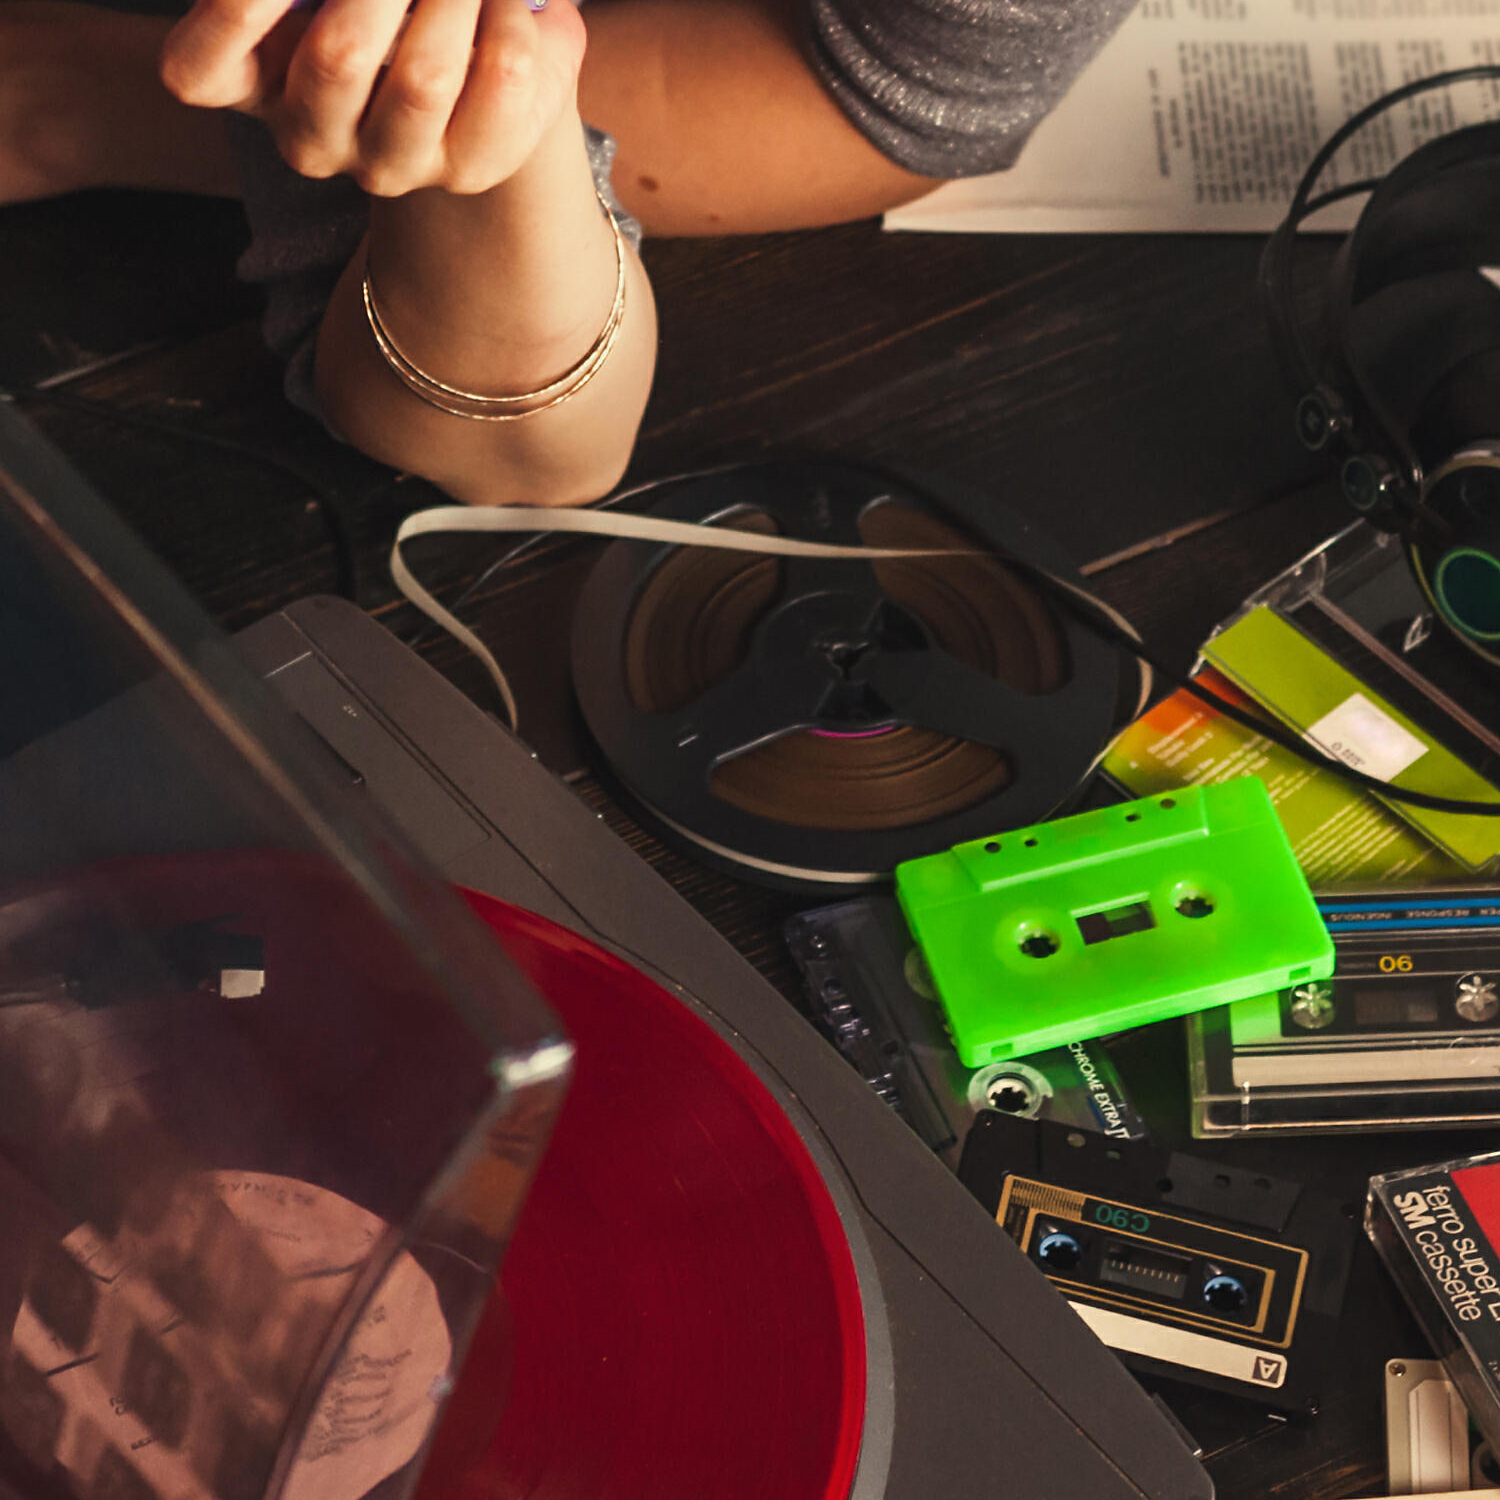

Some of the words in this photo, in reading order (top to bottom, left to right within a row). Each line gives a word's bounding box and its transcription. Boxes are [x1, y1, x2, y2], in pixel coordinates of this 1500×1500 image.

[1406, 908, 1470, 919] RESPONSE
[1379, 955, 1413, 973] 90
[1068, 1041, 1105, 1092] CHROME
[1094, 1092, 1122, 1129] EXTRA
[1095, 1204, 1150, 1234] C90
[1422, 1185, 1464, 1235] ferro
[1393, 1191, 1437, 1230] SM
[1415, 1230, 1482, 1322] cassette
[1258, 1358, 1279, 1380] A
